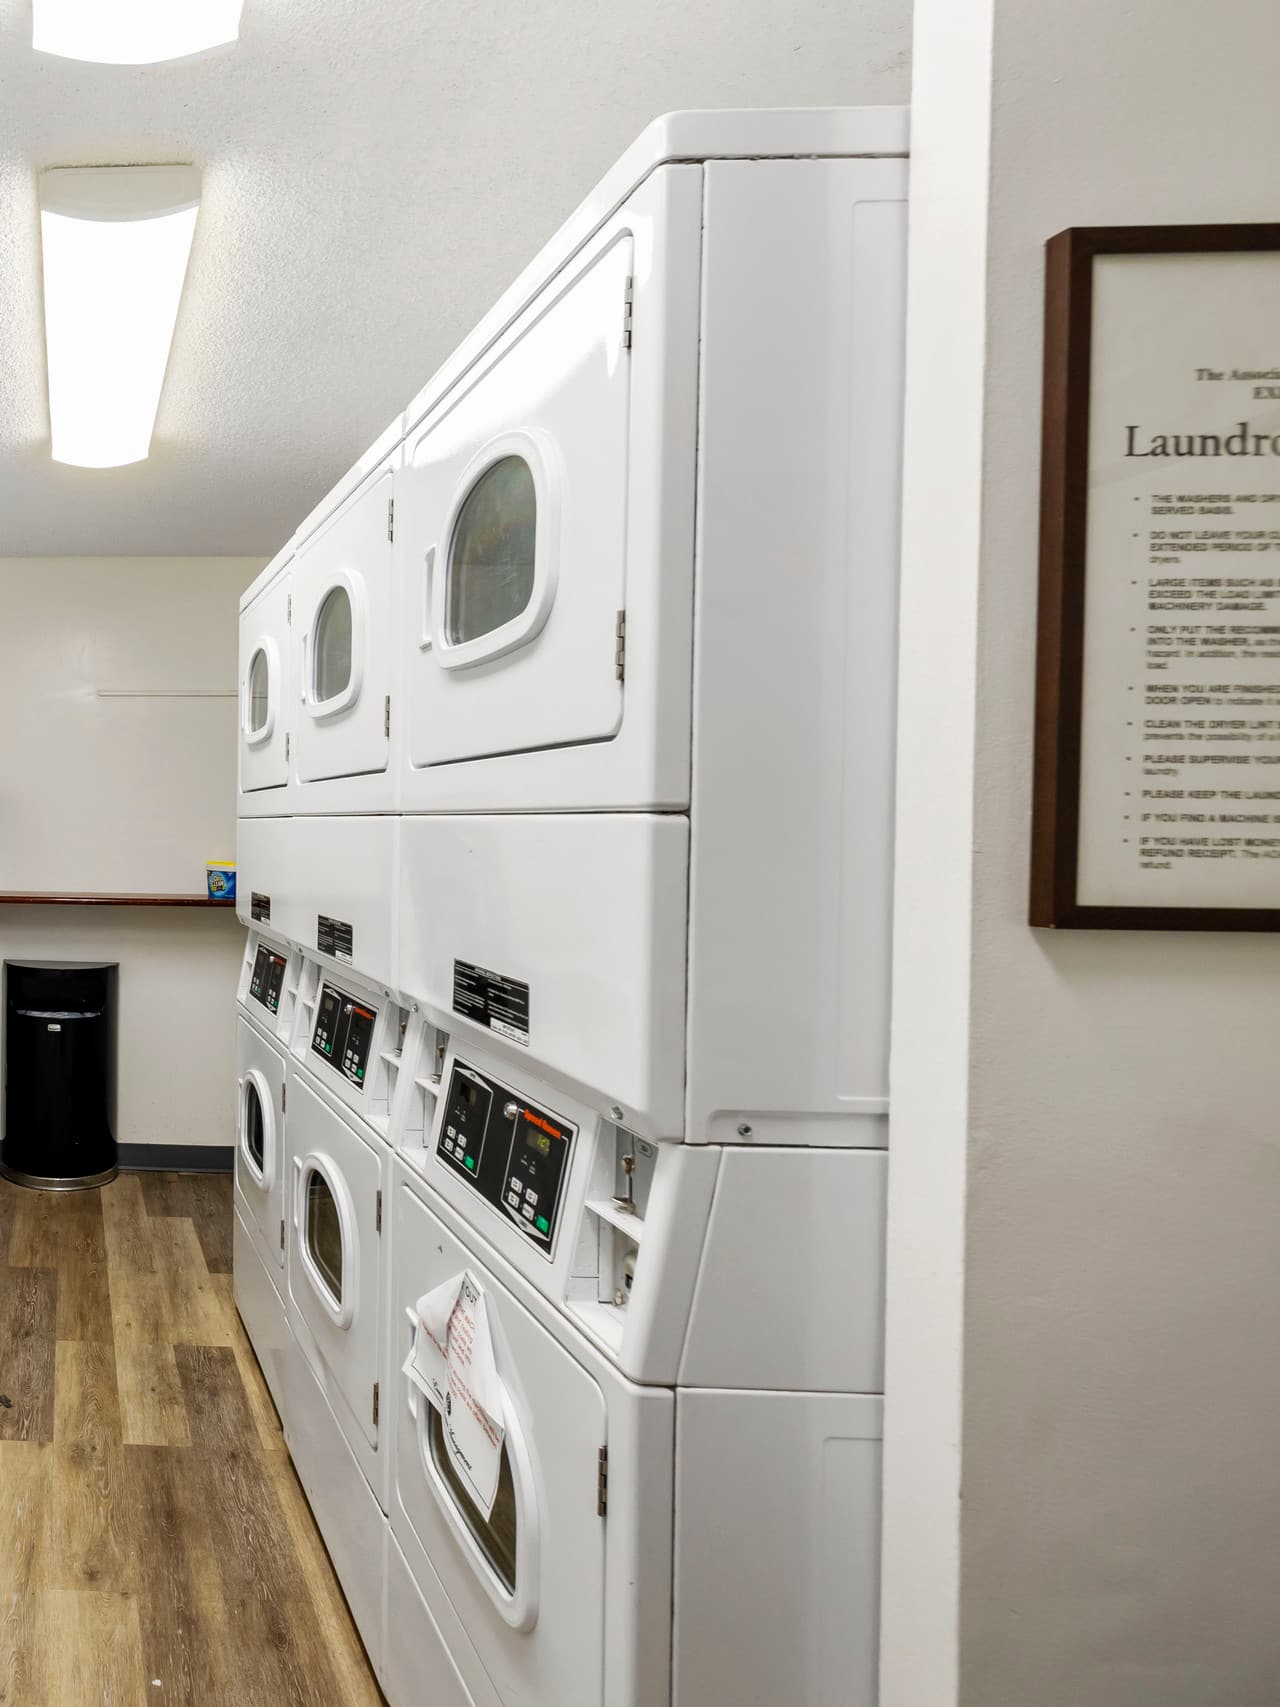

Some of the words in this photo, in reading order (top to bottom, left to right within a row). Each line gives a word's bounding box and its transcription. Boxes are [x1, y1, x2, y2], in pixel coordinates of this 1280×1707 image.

[1152, 494, 1172, 504] THE
[1176, 494, 1231, 504] WASHERS
[1148, 578, 1185, 587] LARGE
[1148, 602, 1213, 610] MACHINERY
[1144, 720, 1180, 729] CLEAN
[1143, 754, 1186, 764] PLEASE
[1142, 790, 1185, 799] PLEASE
